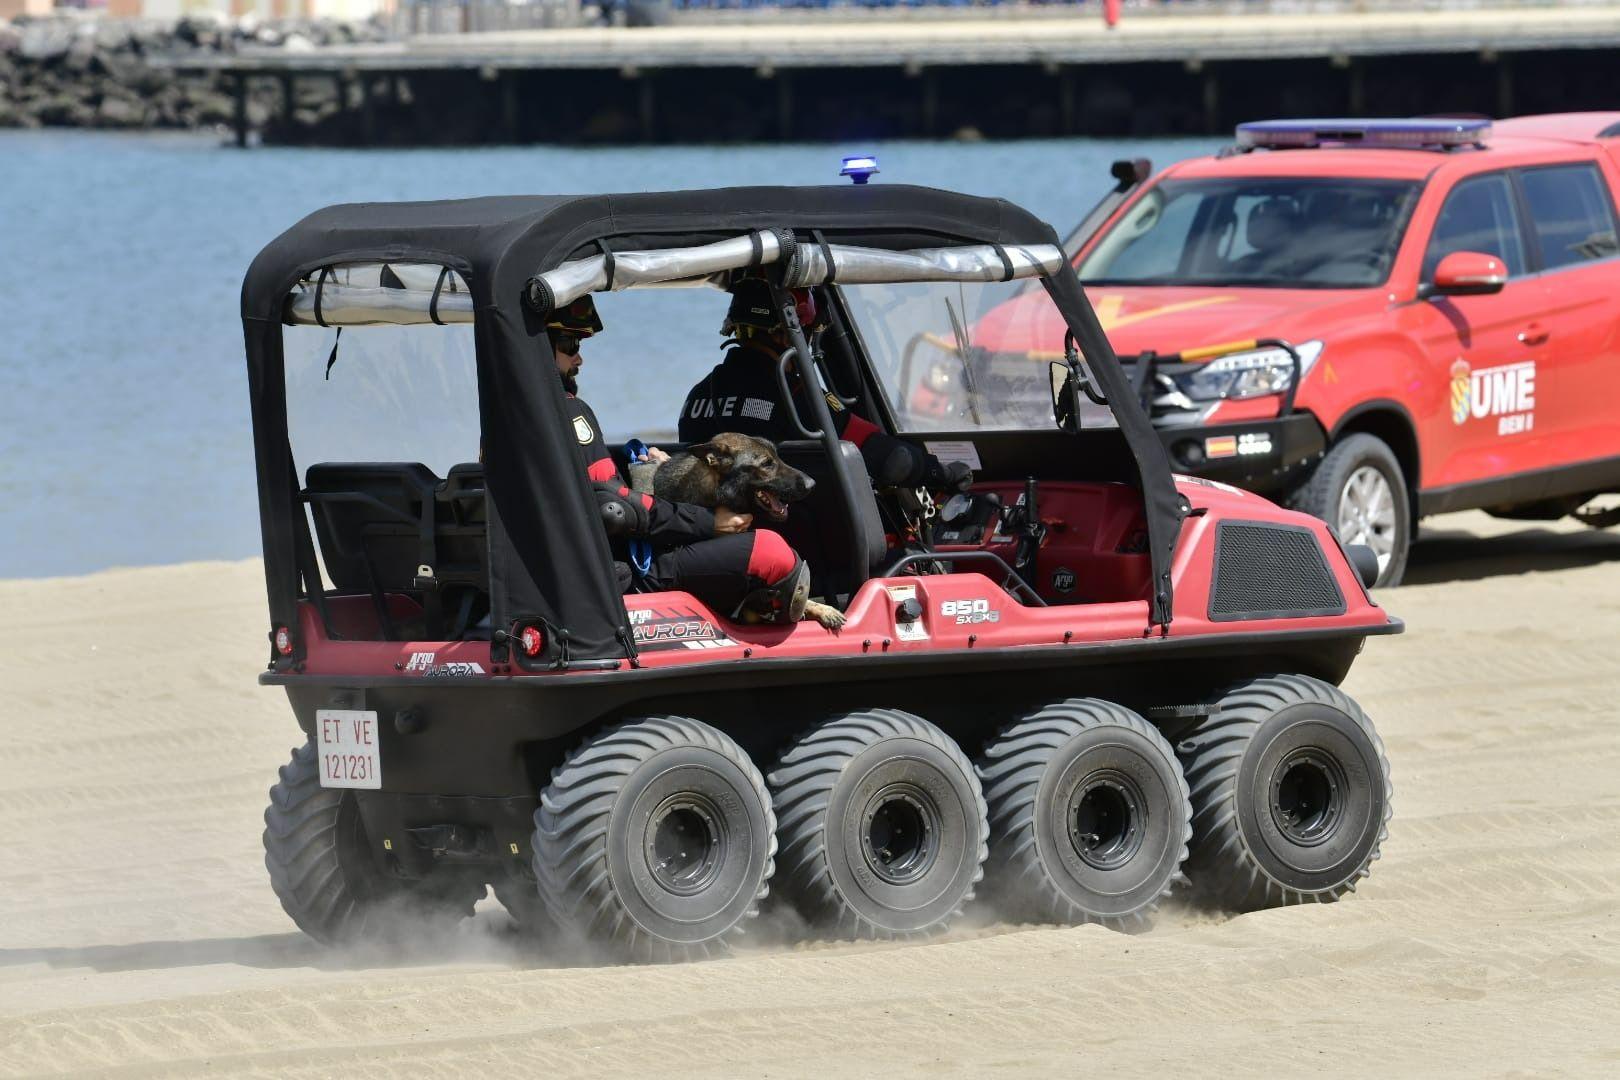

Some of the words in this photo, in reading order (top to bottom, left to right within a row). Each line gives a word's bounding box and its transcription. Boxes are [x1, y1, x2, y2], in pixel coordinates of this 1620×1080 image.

[1470, 366, 1536, 419] UME
[940, 598, 989, 617] 850
[632, 621, 716, 641] AURORA
[422, 664, 477, 677] AURORA
[323, 718, 342, 744] ET
[353, 719, 373, 745] VE
[324, 753, 373, 780] 121231
